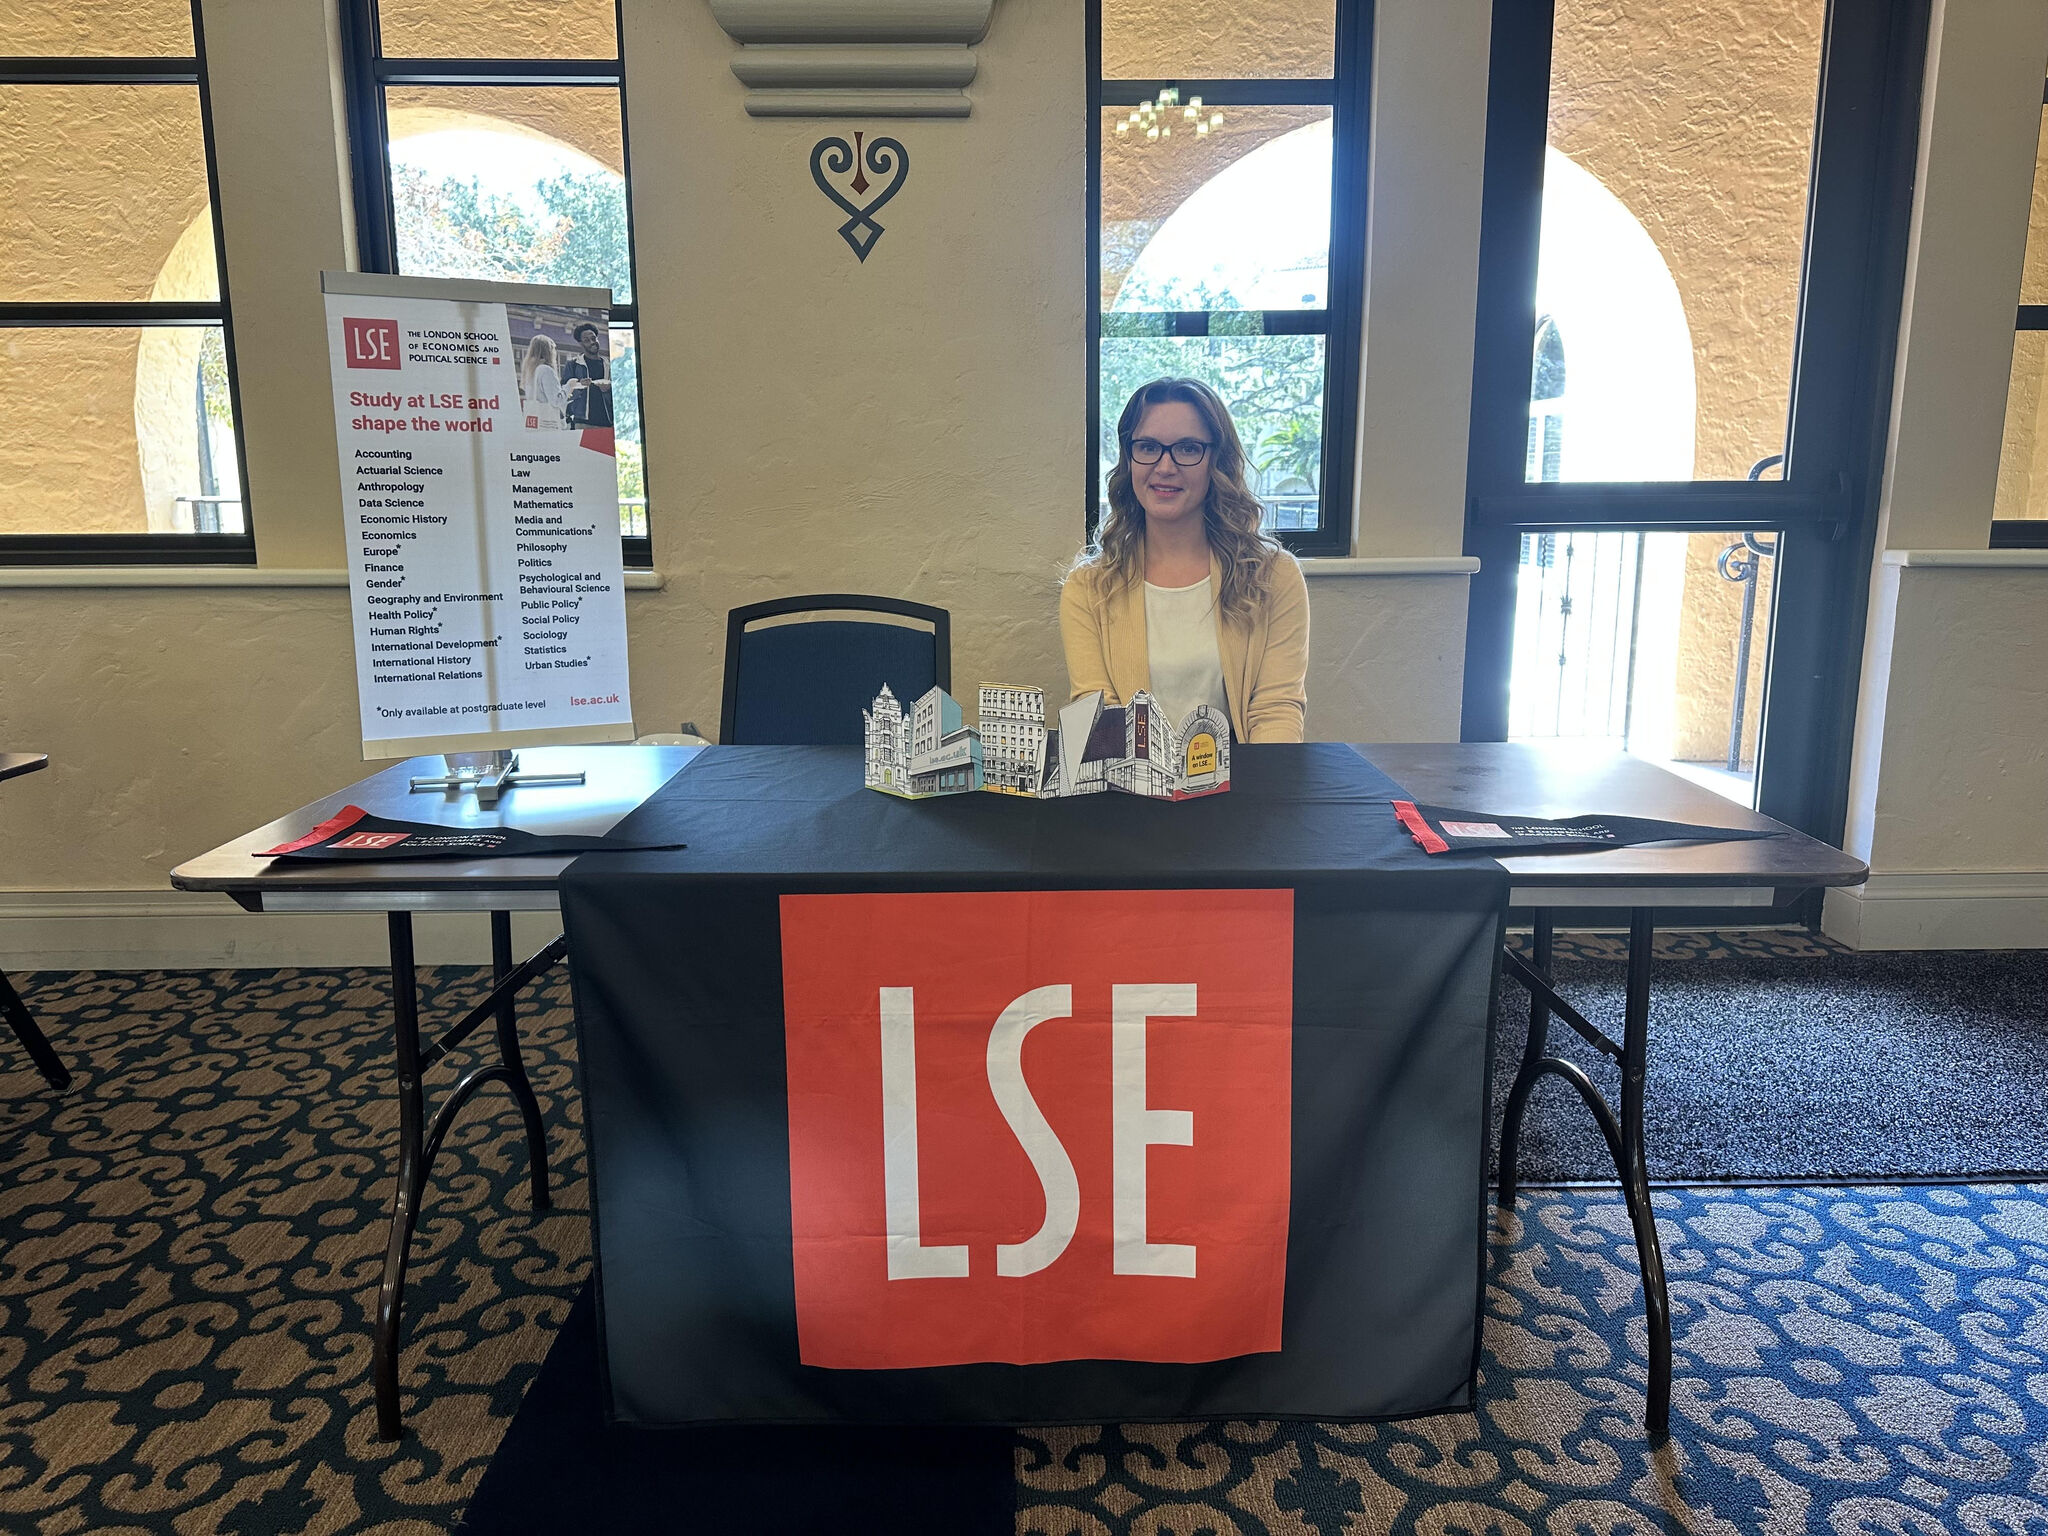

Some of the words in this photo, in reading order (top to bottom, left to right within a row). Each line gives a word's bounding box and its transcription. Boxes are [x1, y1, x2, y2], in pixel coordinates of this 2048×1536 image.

[423, 330, 462, 339] LONDON
[464, 332, 498, 341] SCHOOL
[354, 327, 391, 360] LSE
[423, 342, 480, 352] ECONOMICS
[409, 354, 452, 364] POLITICAL
[454, 356, 487, 364] SCIENCE
[350, 392, 402, 411] Study
[408, 394, 425, 408] at
[430, 394, 463, 408] LSE
[468, 395, 500, 410] and
[352, 416, 406, 434] shape
[411, 417, 440, 431] the
[446, 418, 492, 432] world
[527, 417, 536, 427] LSE
[355, 449, 412, 460] Accounting
[510, 453, 561, 463] Languages
[356, 466, 401, 475] Actuarial
[404, 466, 443, 475] Science
[511, 469, 530, 477] Law
[358, 482, 424, 492] Anthropology
[512, 485, 573, 494] Management
[359, 498, 383, 507] Data
[385, 498, 424, 507] Science
[513, 500, 573, 509] Mathematics
[360, 515, 410, 524] Economic
[412, 515, 448, 525] History
[515, 516, 543, 524] Media
[546, 516, 562, 524] and
[362, 531, 417, 540] Economics
[516, 543, 567, 553] Philosophy
[365, 563, 404, 572] Finance
[518, 558, 552, 567] Politics
[519, 573, 583, 583] Psychological
[585, 572, 601, 581] and
[520, 585, 573, 594] Behavioural
[575, 584, 610, 593] Science
[367, 594, 421, 606] Geography
[423, 594, 441, 603] and
[444, 592, 503, 602] Environment
[521, 601, 550, 609] Public
[369, 611, 402, 620] Health
[522, 615, 550, 624] Social
[552, 614, 580, 625] Policy
[370, 627, 406, 635] Human
[523, 630, 568, 640] Sociology
[372, 641, 434, 651] International
[524, 645, 567, 655] Statistics
[373, 658, 435, 667] International
[437, 656, 471, 666] History
[525, 661, 553, 670] Urban
[374, 673, 436, 683] International
[438, 670, 482, 680] Relations
[570, 694, 619, 706] lse.ac.uk
[405, 706, 448, 716] available
[450, 705, 459, 714] at
[461, 702, 523, 715] postgraduate
[525, 700, 546, 710] level
[1138, 714, 1146, 748] LSE
[344, 835, 397, 846] LSE
[879, 983, 1198, 1281] LSE
